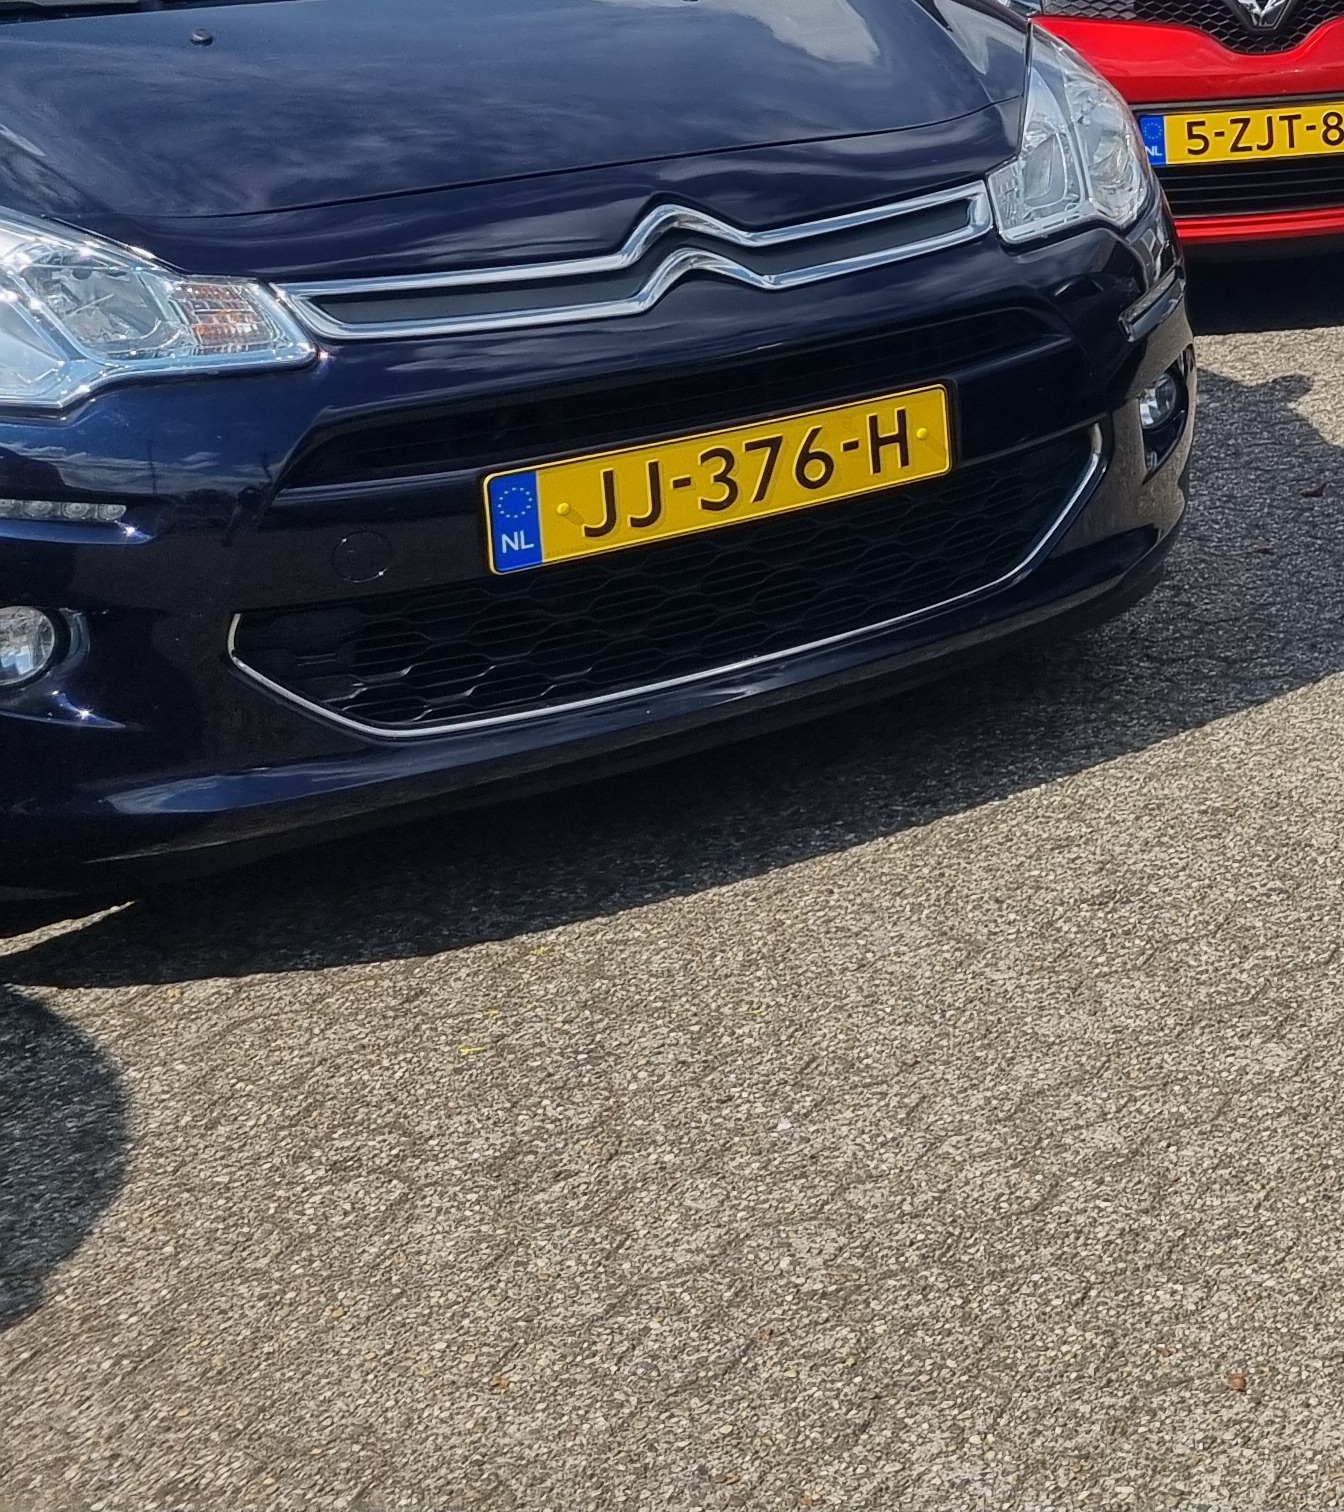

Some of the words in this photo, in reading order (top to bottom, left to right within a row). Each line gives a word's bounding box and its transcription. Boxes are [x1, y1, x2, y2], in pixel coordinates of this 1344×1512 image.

[1145, 146, 1162, 156] NL
[583, 406, 911, 538] JJ-376-H
[501, 529, 535, 554] NL
